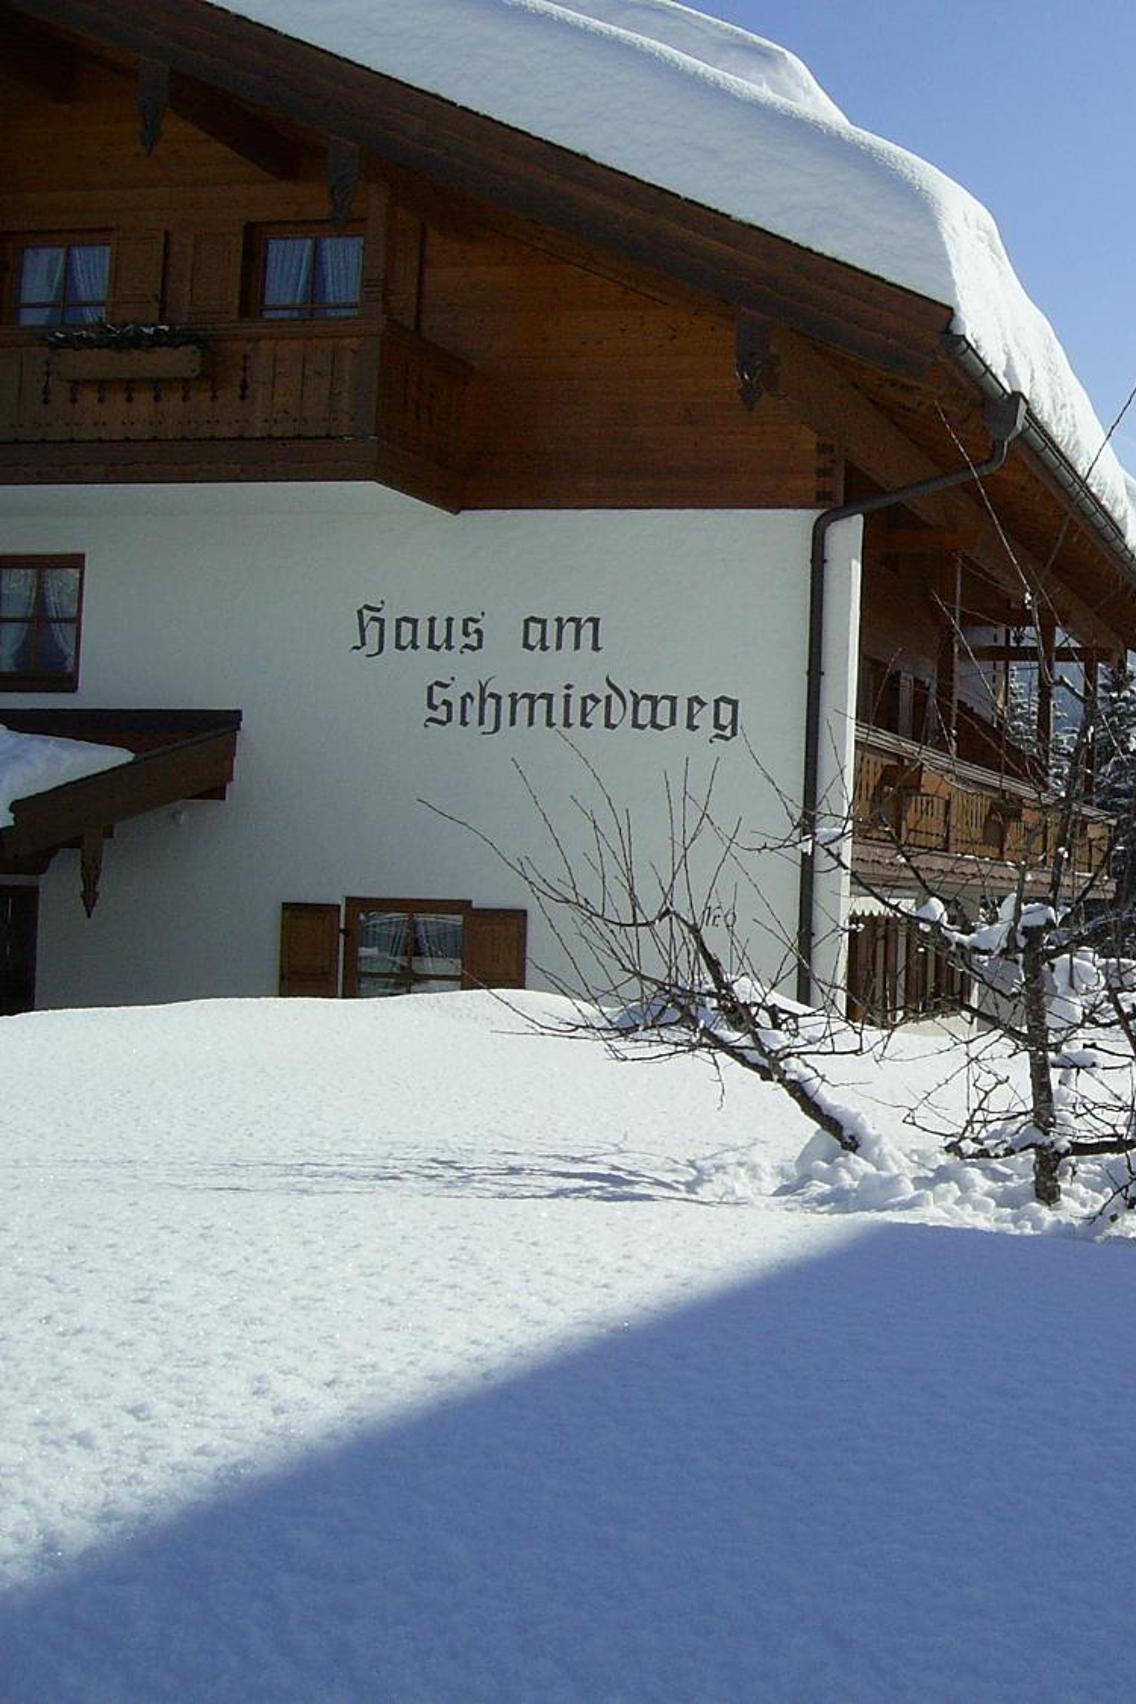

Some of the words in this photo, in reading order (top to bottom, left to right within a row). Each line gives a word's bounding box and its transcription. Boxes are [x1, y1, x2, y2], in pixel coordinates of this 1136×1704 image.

[351, 600, 485, 657] Haus
[521, 614, 604, 653] am
[424, 675, 740, 744] Schmiedweg
